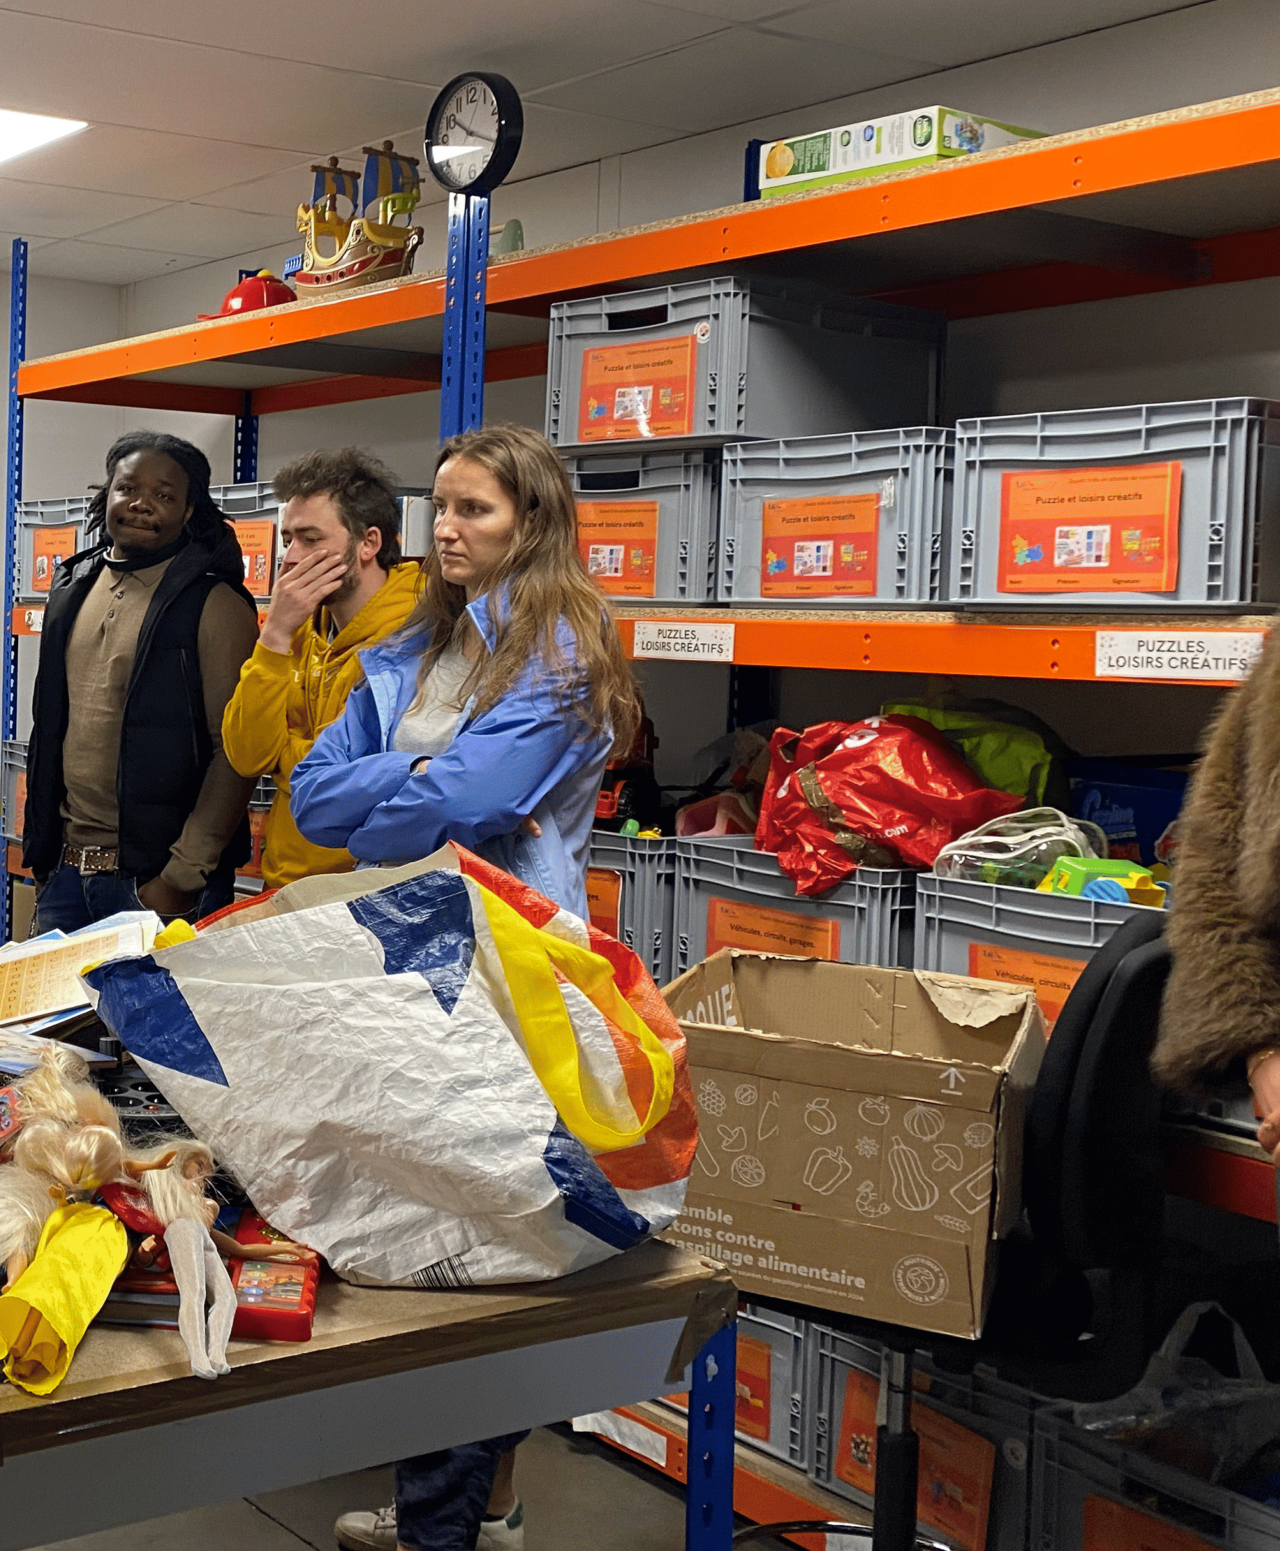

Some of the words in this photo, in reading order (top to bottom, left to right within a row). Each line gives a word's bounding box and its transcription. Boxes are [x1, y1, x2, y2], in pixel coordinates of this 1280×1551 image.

[466, 87, 477, 105] 12
[456, 97, 462, 113] 11
[456, 163, 464, 178] 7
[468, 163, 477, 180] 6
[633, 361, 650, 370] loisirs
[1035, 496, 1065, 505] Puzzle
[1067, 495, 1077, 503] et
[1078, 494, 1105, 502] loisirs
[1107, 492, 1142, 502] créatifs
[781, 516, 802, 524] Puzzle
[810, 514, 830, 522] loisirs
[657, 628, 700, 641] PUZZLES,
[641, 640, 672, 652] LOISIRS
[673, 640, 724, 654] CRÉATIFS
[1137, 640, 1210, 655] PUZZLES,
[1108, 656, 1163, 669] LOISIRS
[1168, 654, 1248, 671] CRÉATIFS
[730, 923, 762, 937] Véhicules,
[995, 969, 1036, 985] Véhicules,
[681, 1205, 734, 1225] emble
[667, 1220, 712, 1239] tons
[715, 1230, 775, 1252] contre
[666, 1237, 754, 1267] gaspillage
[758, 1255, 866, 1289] alimentaire
